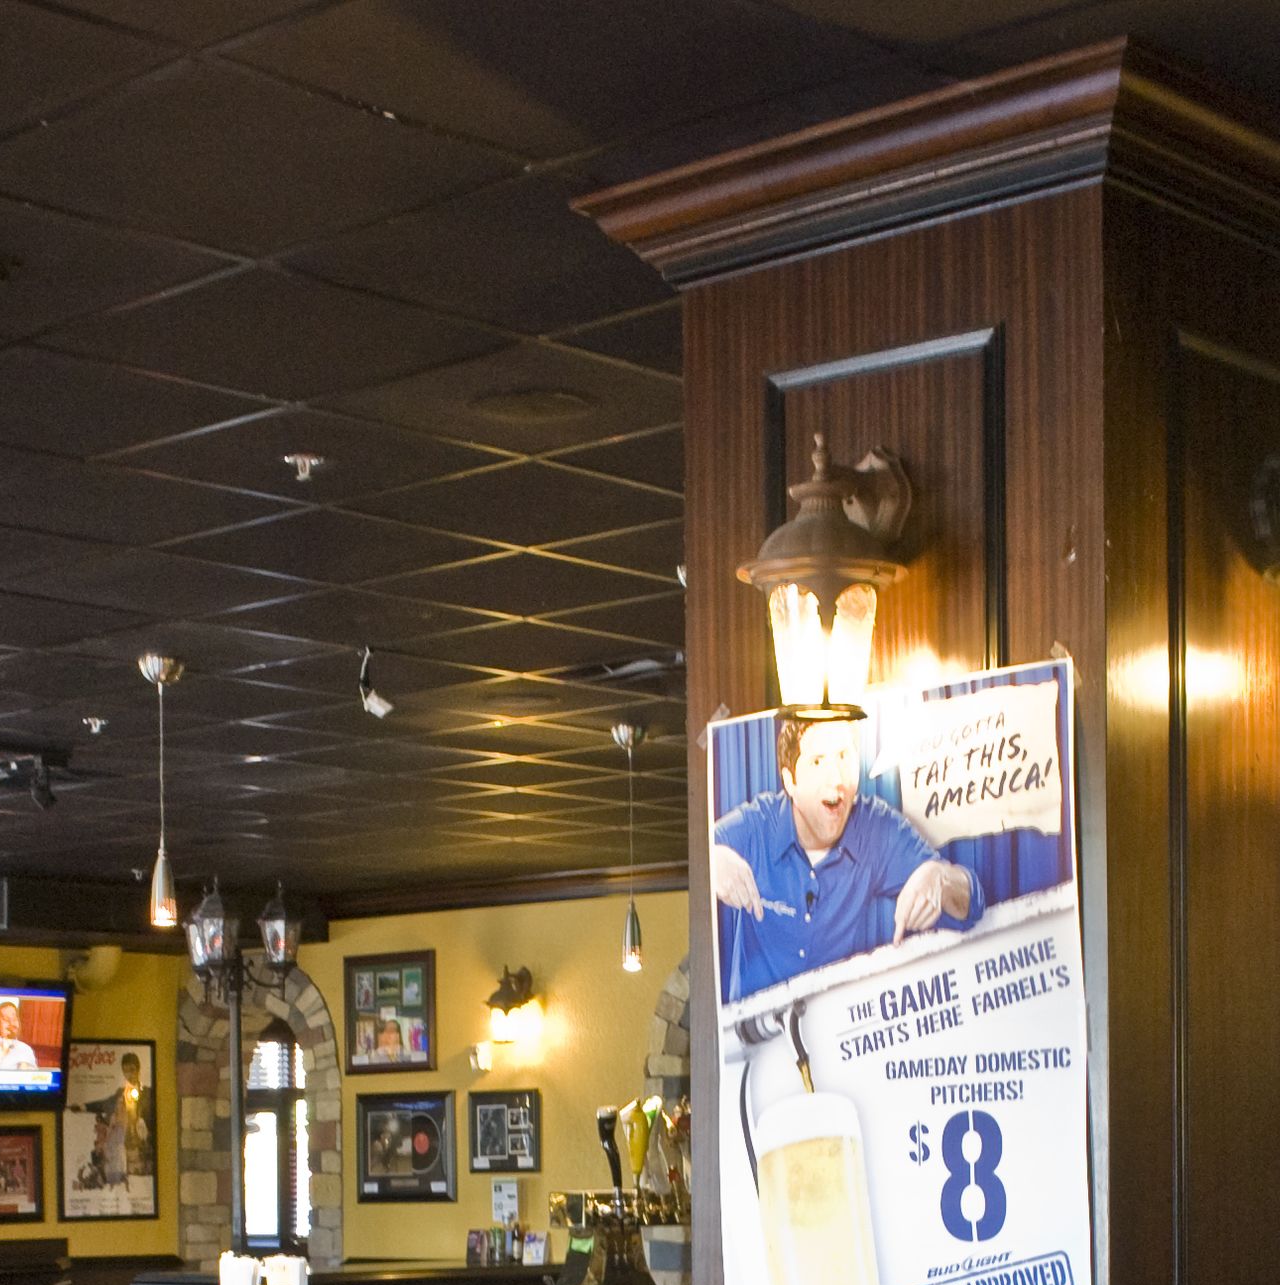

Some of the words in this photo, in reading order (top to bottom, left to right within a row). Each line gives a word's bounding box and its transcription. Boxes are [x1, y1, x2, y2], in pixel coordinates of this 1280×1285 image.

[964, 733, 1028, 771] THIS,
[924, 757, 1053, 819] AMERICA!
[974, 937, 1058, 984] FRANKIE
[848, 998, 876, 1023] THE
[879, 969, 960, 1022] GAME
[971, 964, 1071, 1016] FARRELL'S
[839, 1021, 910, 1061] STARTS
[915, 1004, 964, 1038] HERE
[885, 1054, 968, 1080] GAMEDAY
[975, 1046, 1072, 1075] DOMESTIC
[930, 1079, 1024, 1105] PITCHERS!
